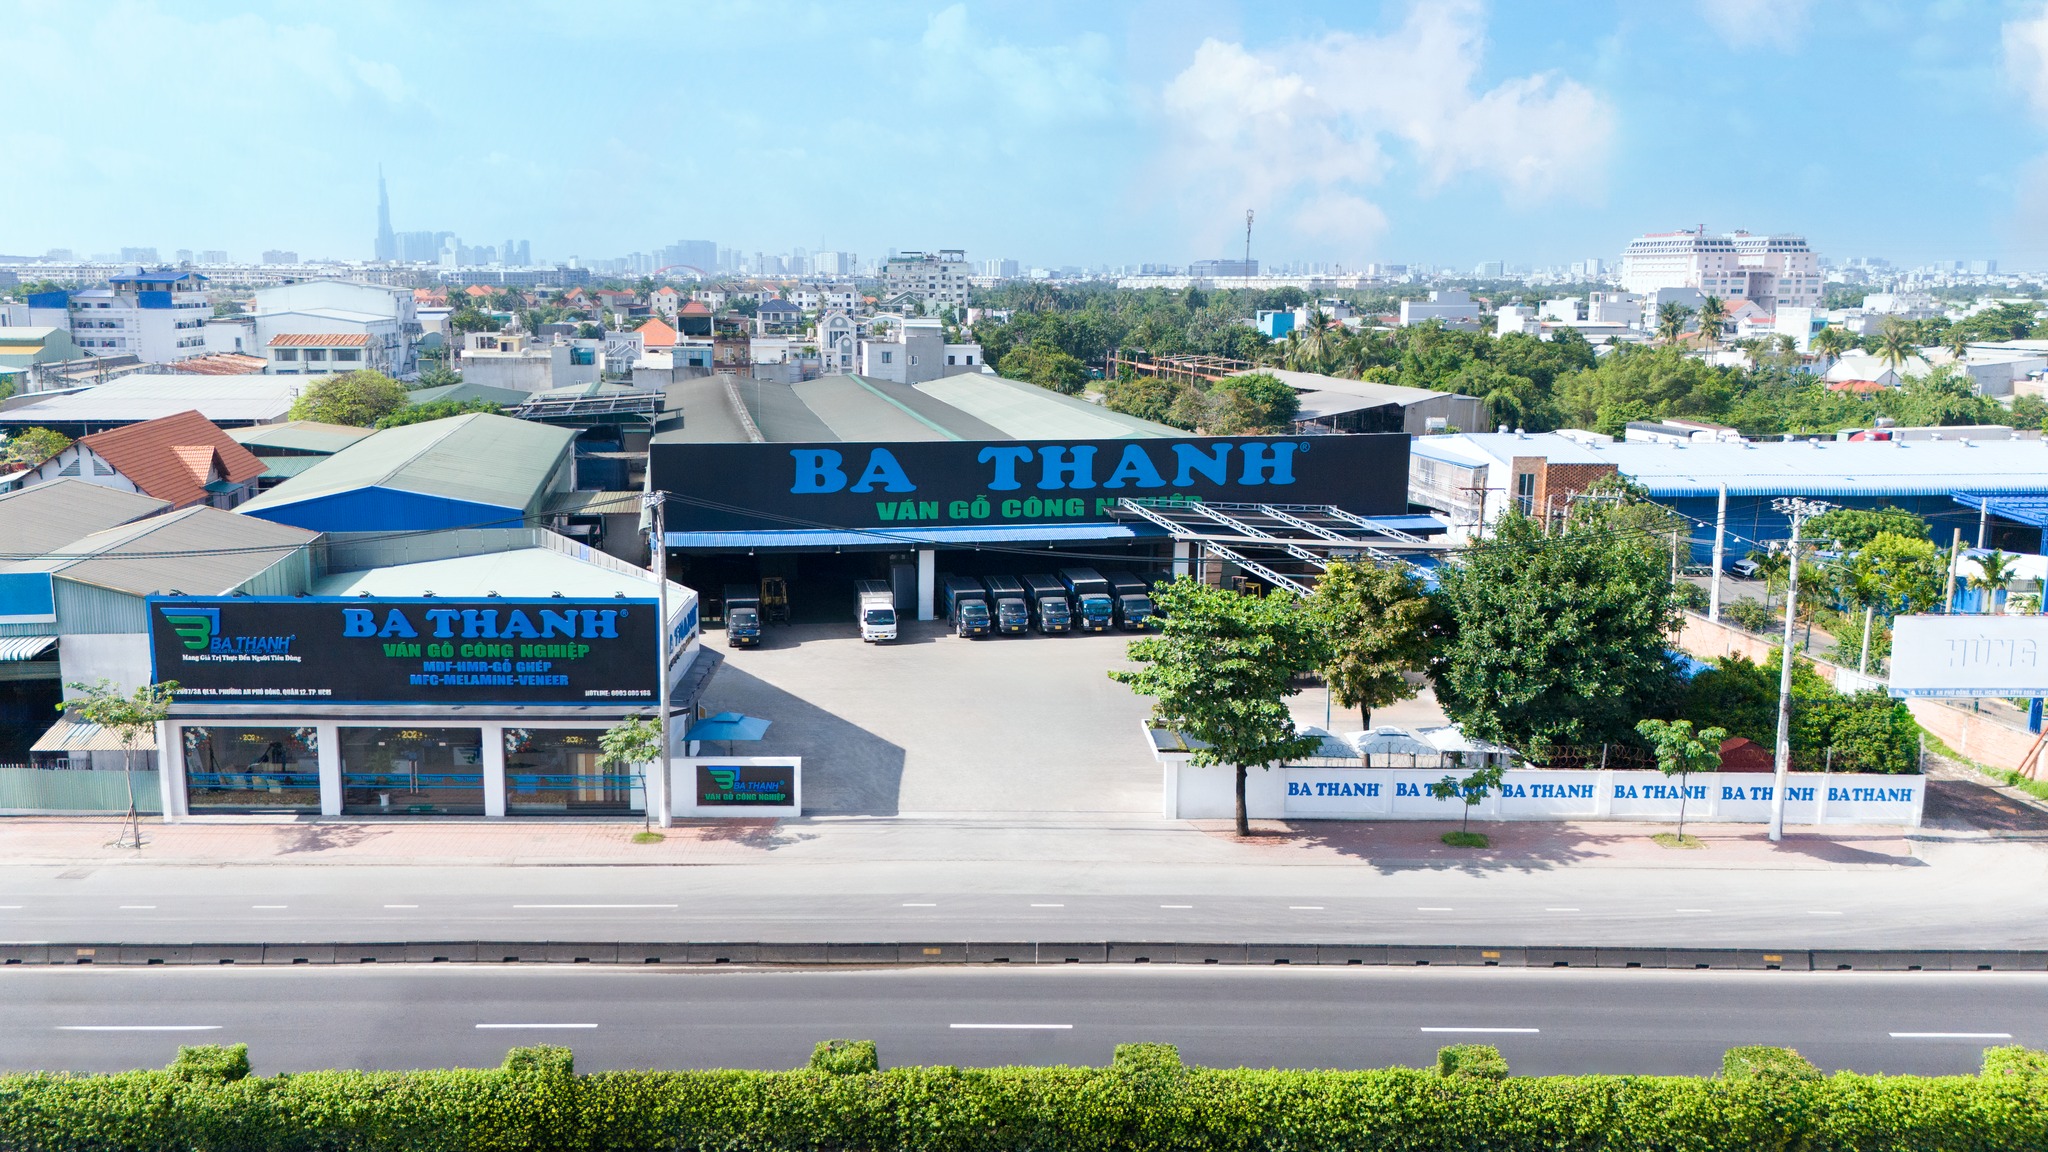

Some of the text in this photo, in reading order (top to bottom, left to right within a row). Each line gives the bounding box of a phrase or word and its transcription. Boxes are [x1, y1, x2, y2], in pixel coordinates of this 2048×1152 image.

[790, 442, 1298, 494] BA THANH
[876, 498, 939, 520] VÁN
[949, 495, 991, 519] GỖ
[1001, 495, 1085, 518] CÔNG
[342, 608, 618, 639] BA THANH
[210, 637, 291, 650] BA THANH
[382, 641, 590, 660] VÁN GỖ CÔNG NGHIỆP
[182, 654, 199, 662] Mang
[516, 660, 552, 673] GHÉP
[410, 674, 569, 686] MFC-MELAMINE-VENEER
[734, 781, 779, 790] BA THANH
[1288, 782, 1379, 797] BA THANH
[1396, 782, 1420, 797] BA
[1501, 783, 1594, 798] BA THANH
[1614, 785, 1707, 800] BA THANH
[1722, 786, 1746, 800] BA
[705, 792, 721, 801] VÁN
[735, 792, 757, 801] CÔNG
[758, 792, 786, 802] NGHIỆP
[1828, 787, 1912, 802] BA THANH
